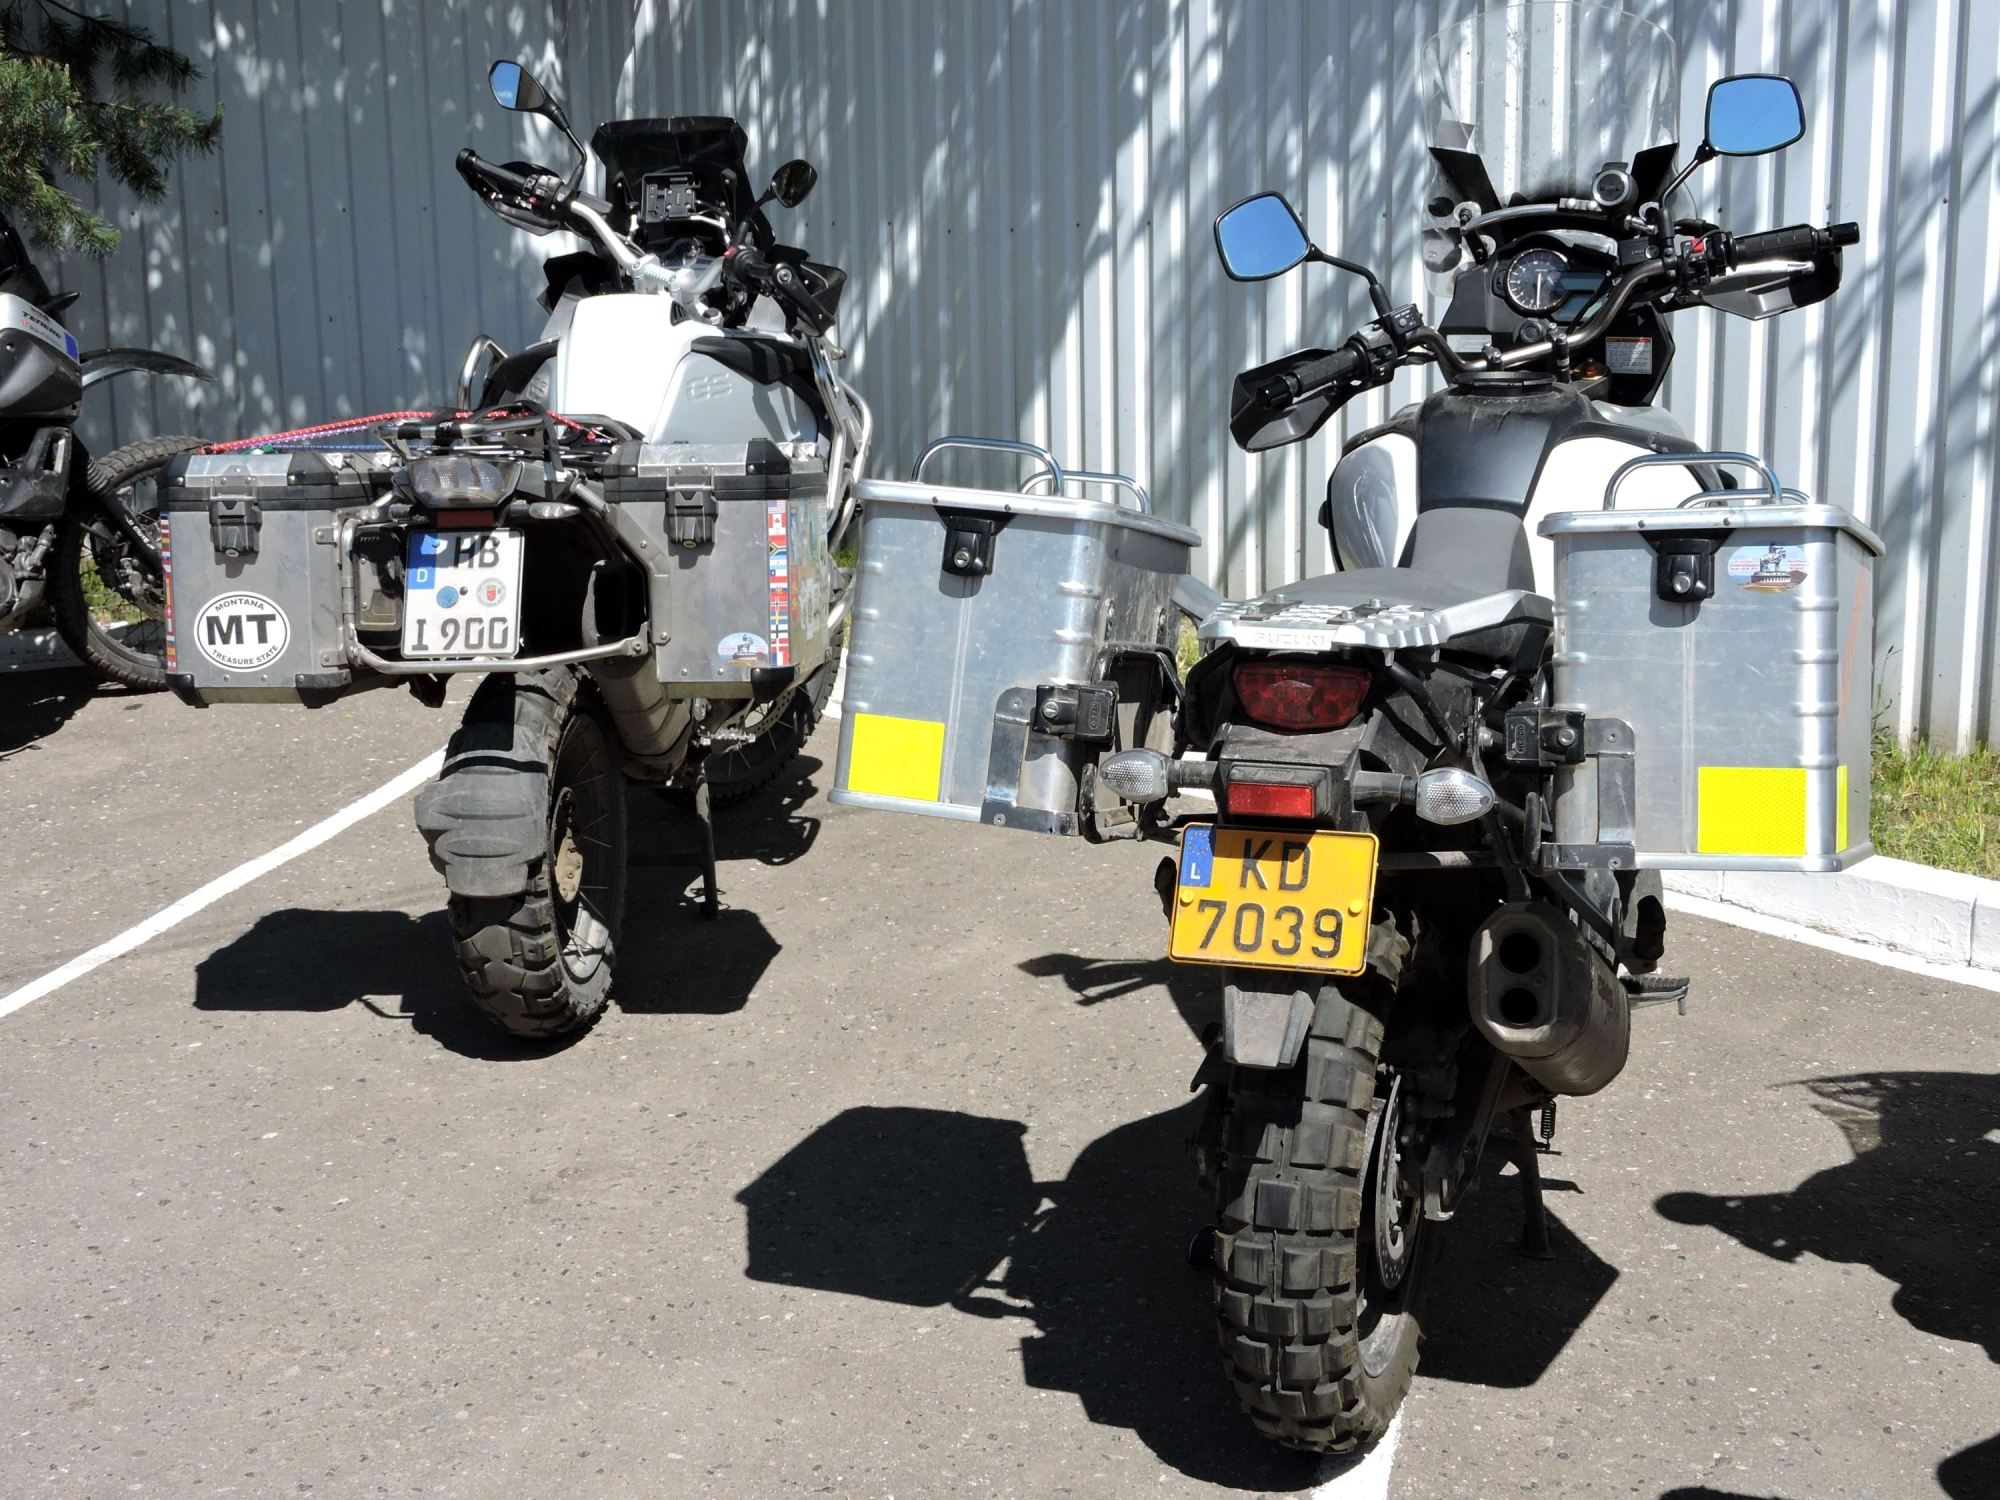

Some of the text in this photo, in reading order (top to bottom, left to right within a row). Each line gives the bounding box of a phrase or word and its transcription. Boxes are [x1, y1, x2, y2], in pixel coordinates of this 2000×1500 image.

[453, 535, 500, 569] HB
[416, 569, 428, 583] D
[215, 598, 264, 612] MONTANA
[206, 614, 276, 645] MT
[412, 617, 510, 651] I 900
[1254, 632, 1325, 647] SUZUKI
[212, 644, 279, 665] TREASURE STATE
[1190, 862, 1201, 880] L
[1240, 838, 1312, 891] KD
[1198, 899, 1344, 959] 7039
